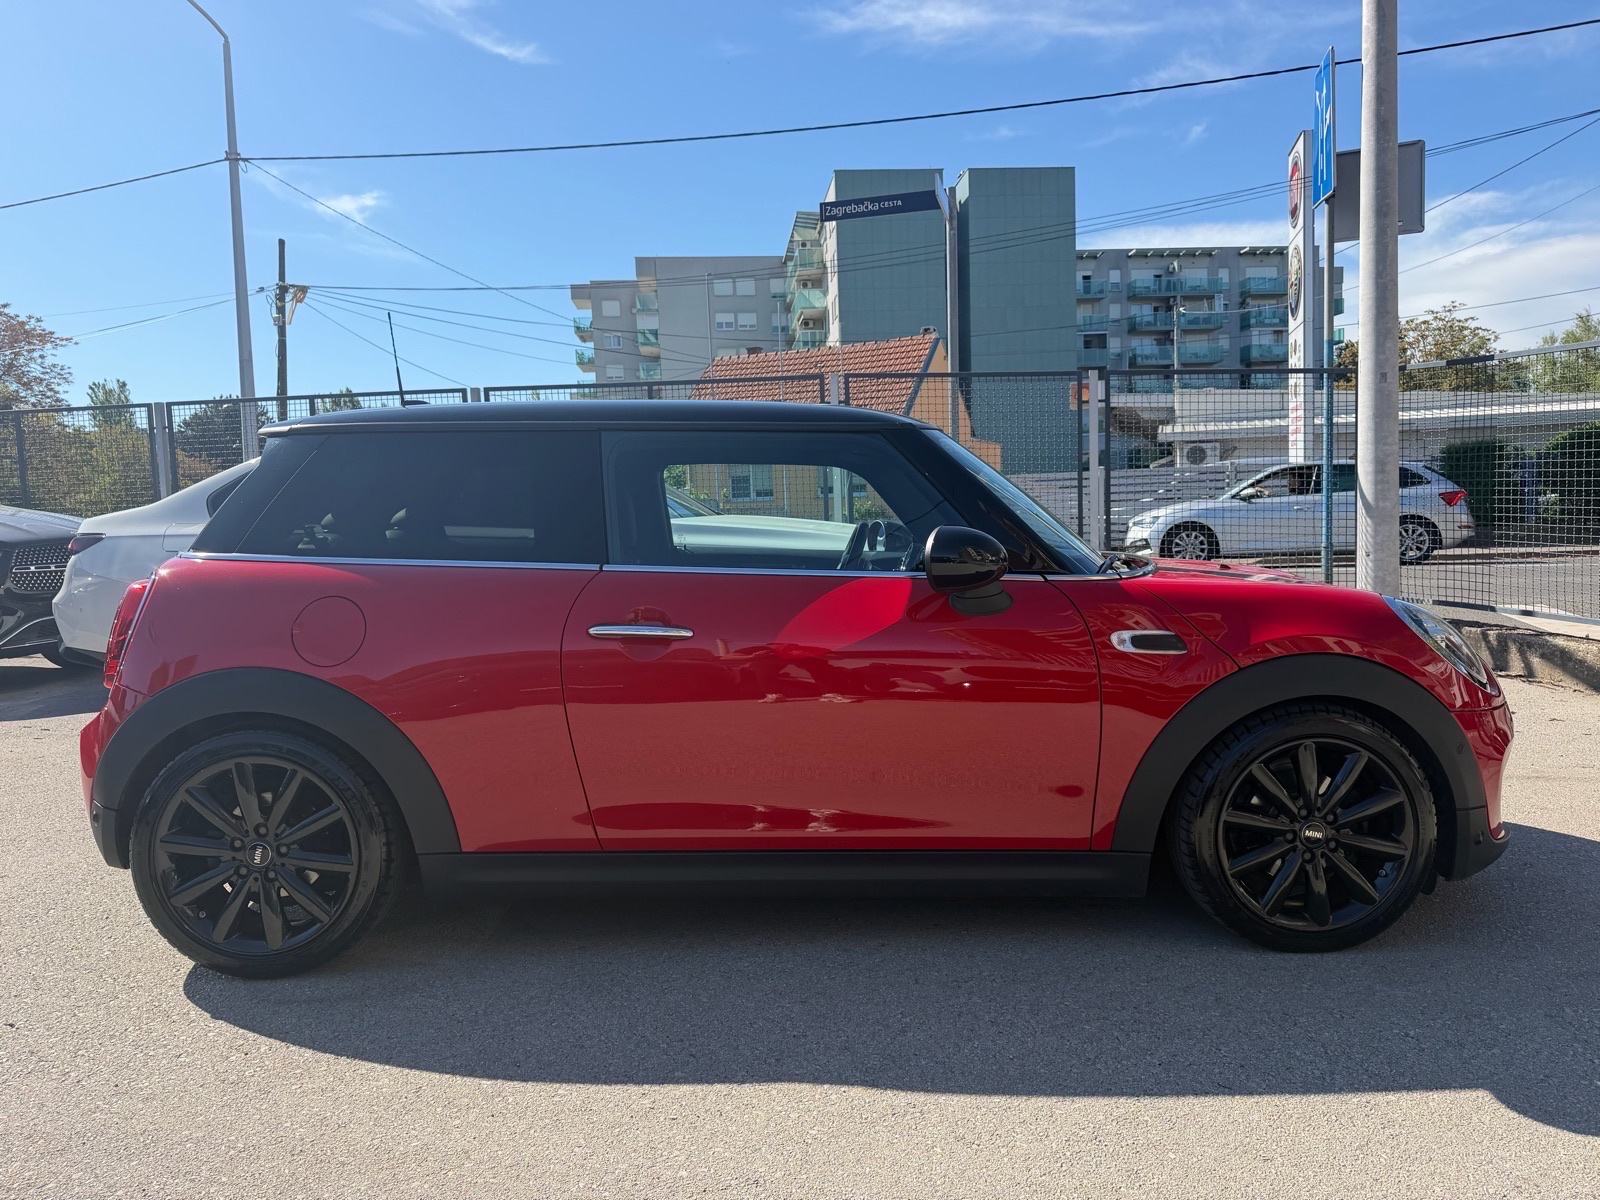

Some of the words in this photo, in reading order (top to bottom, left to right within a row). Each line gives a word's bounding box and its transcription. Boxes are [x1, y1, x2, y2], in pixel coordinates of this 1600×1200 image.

[825, 201, 879, 217] Zagrebačka
[880, 200, 902, 208] CESTA
[1305, 830, 1323, 839] MINI
[254, 846, 264, 864] MINI
